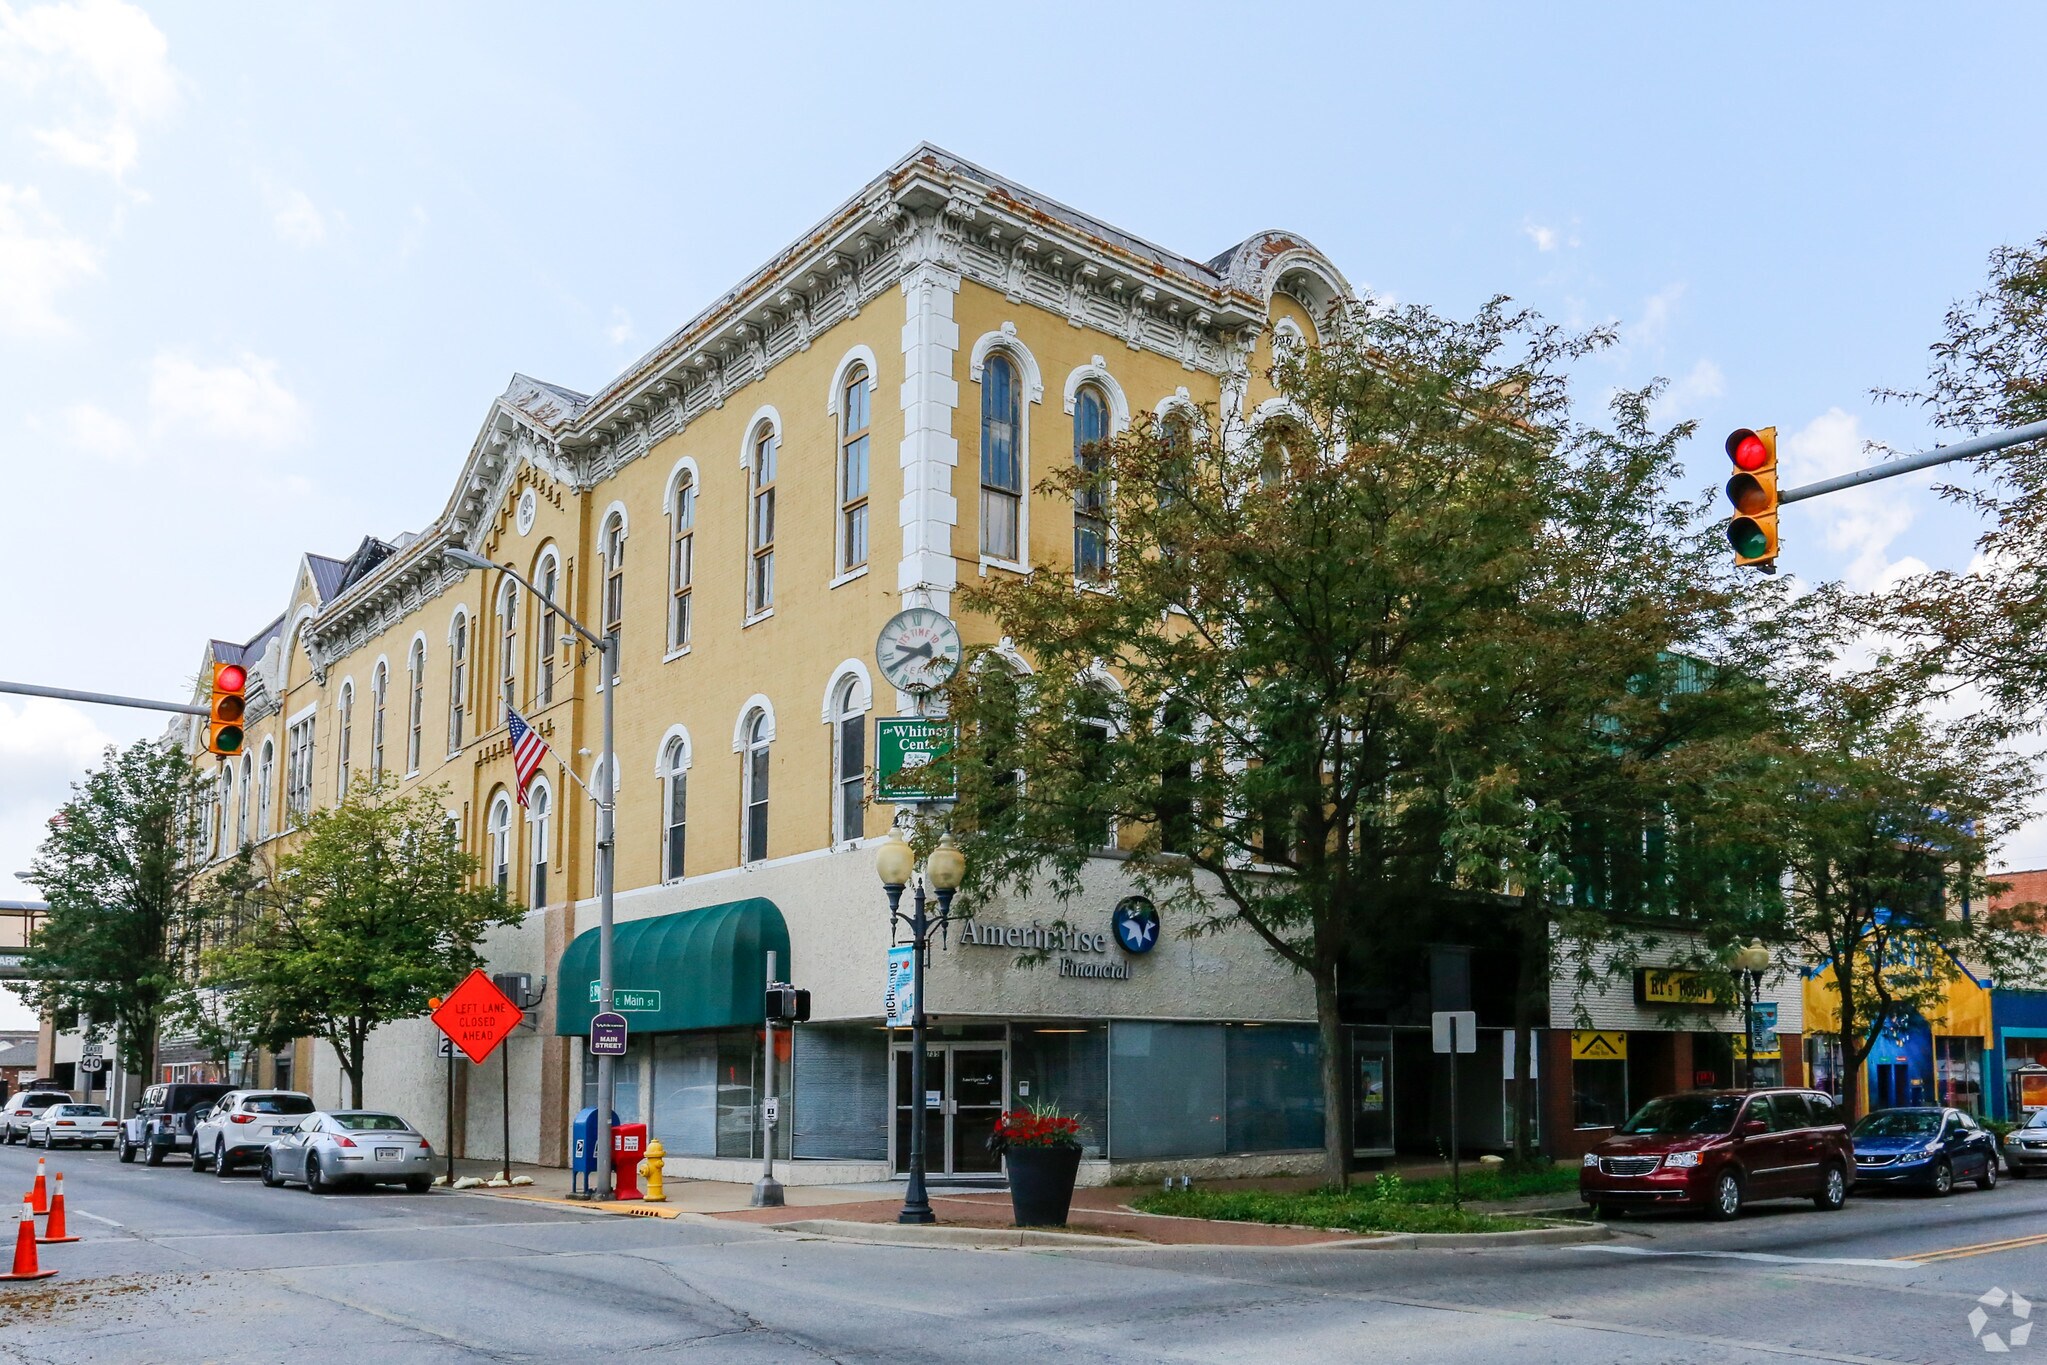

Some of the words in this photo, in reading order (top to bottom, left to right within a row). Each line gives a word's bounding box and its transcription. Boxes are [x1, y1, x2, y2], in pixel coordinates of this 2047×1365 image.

[911, 628, 930, 638] TIME
[930, 634, 940, 644] TO
[960, 918, 1106, 953] Ameriprise
[1059, 957, 1131, 980] Financial
[886, 962, 898, 1018] RICHMOND
[615, 998, 620, 1006] E
[623, 993, 644, 1006] Main
[456, 1004, 477, 1014] LEFT
[483, 1003, 505, 1013] LANE
[460, 1017, 495, 1027] CLOSED
[463, 1031, 493, 1040] AHEAD
[83, 1058, 101, 1068] 40
